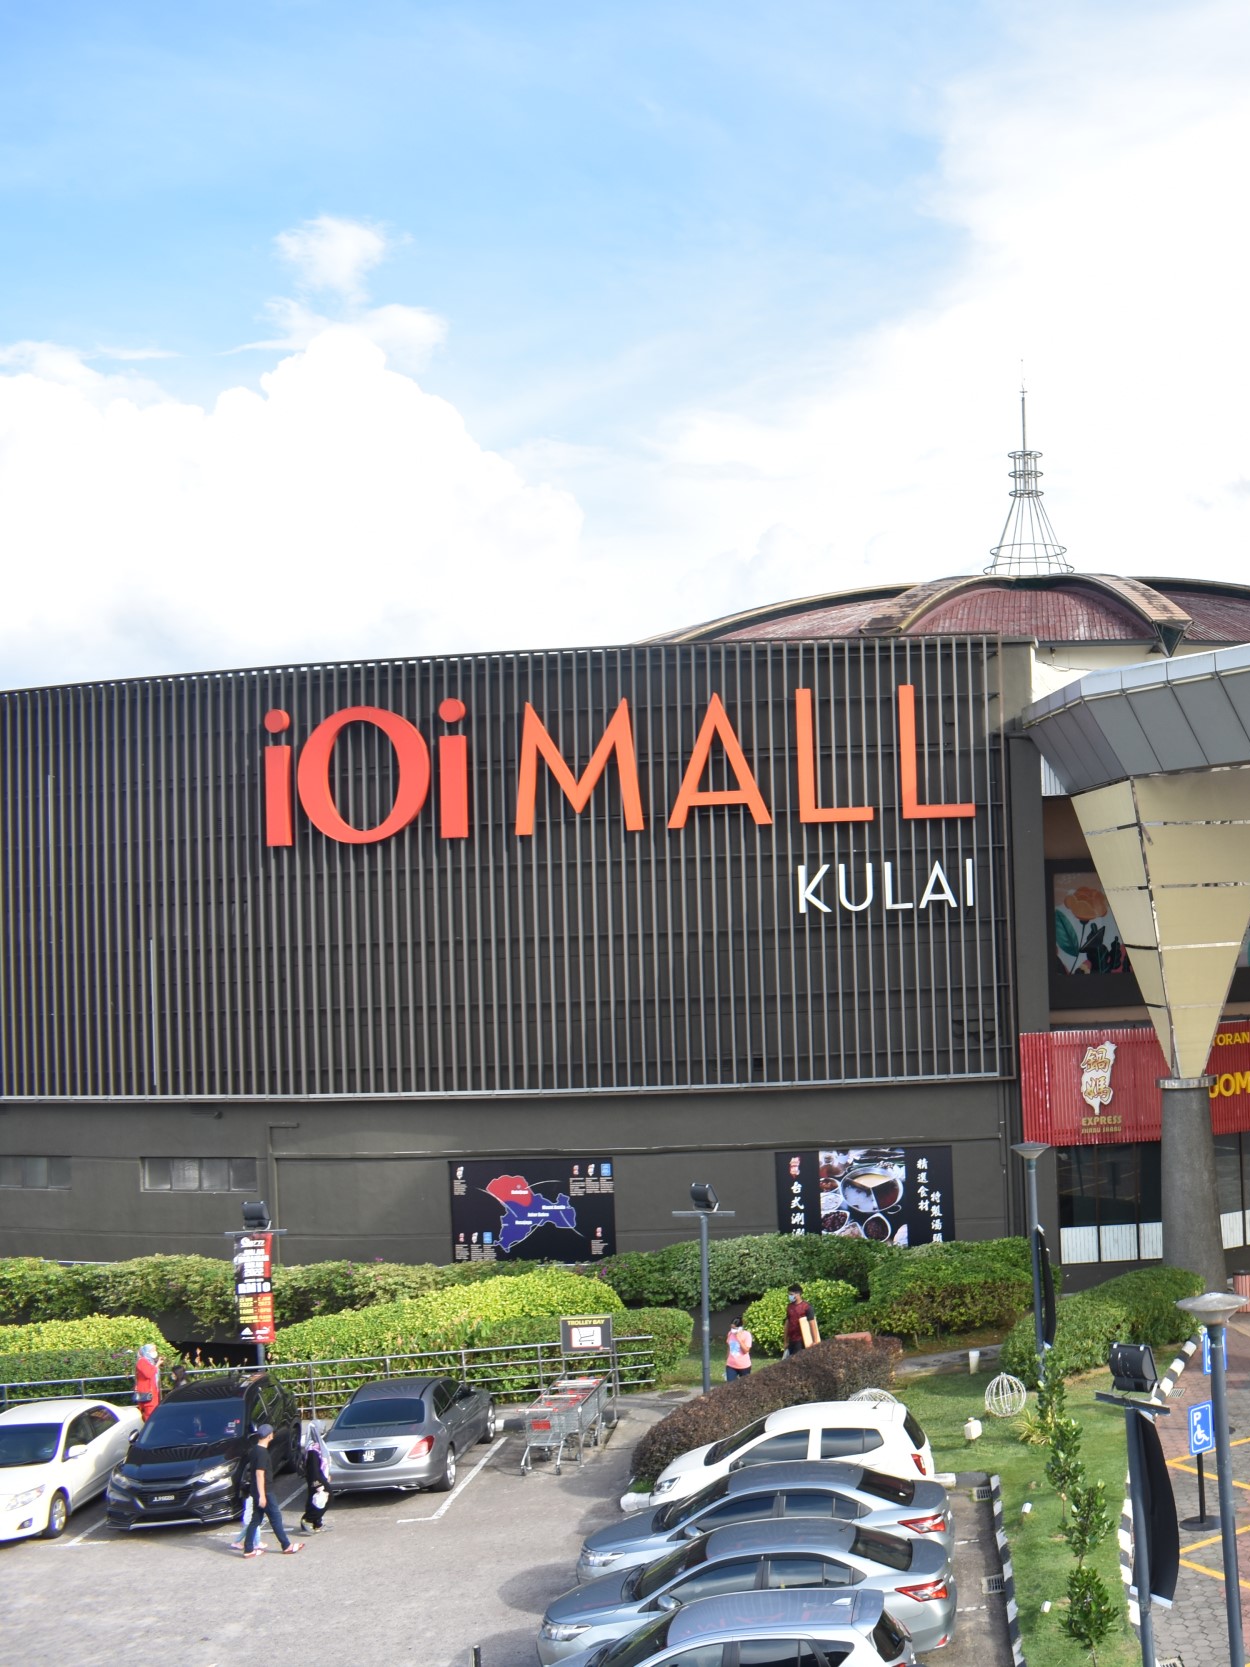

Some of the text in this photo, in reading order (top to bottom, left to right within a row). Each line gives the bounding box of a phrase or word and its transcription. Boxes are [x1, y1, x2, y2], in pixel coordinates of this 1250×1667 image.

[514, 684, 976, 836] MALL
[797, 858, 974, 914] KULAI
[1081, 1116, 1122, 1125] EXPRESS
[917, 1157, 930, 1212] 精選食材
[1193, 1411, 1202, 1426] P
